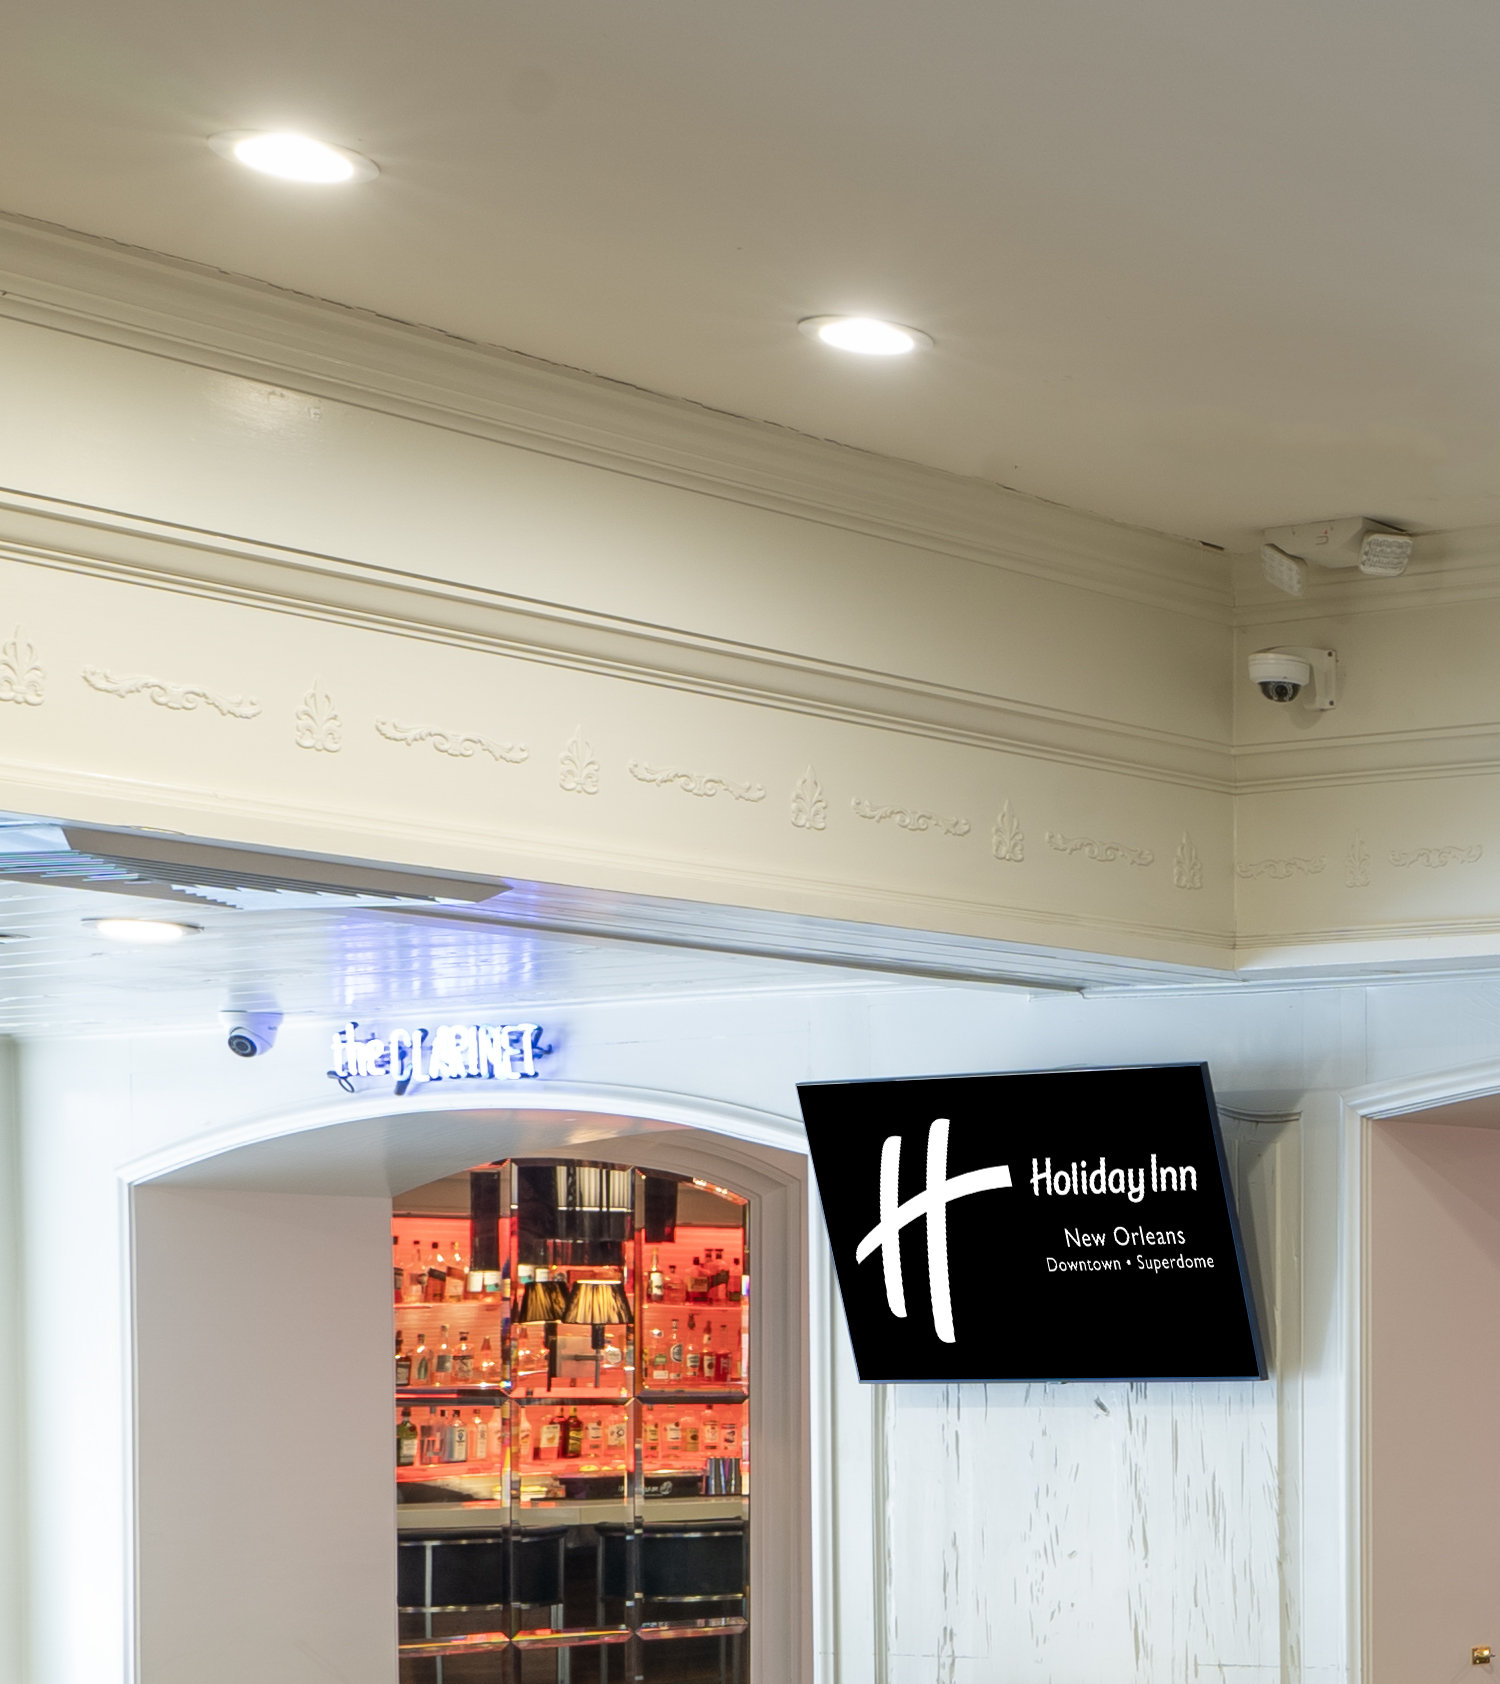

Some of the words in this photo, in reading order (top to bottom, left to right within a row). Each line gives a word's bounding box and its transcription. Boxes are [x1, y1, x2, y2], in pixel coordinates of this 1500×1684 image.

[331, 1021, 389, 1079] the
[389, 1023, 543, 1082] CLARINET
[1029, 1156, 1146, 1204] Holiday
[1150, 1153, 1198, 1193] Inn
[1064, 1227, 1106, 1248] New
[1113, 1225, 1187, 1247] Orleans
[1046, 1256, 1122, 1273] Downtown
[1136, 1253, 1216, 1274] Superdome
